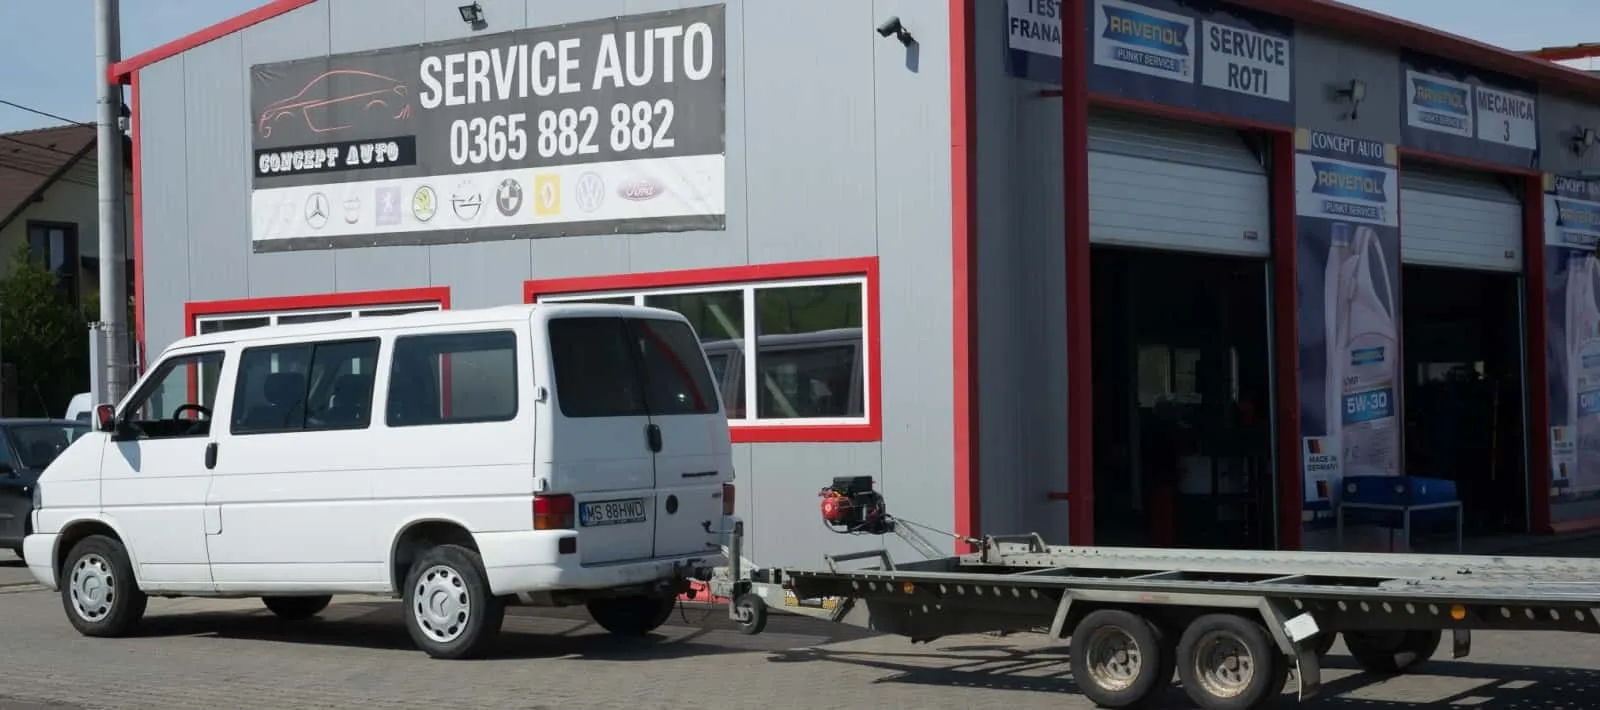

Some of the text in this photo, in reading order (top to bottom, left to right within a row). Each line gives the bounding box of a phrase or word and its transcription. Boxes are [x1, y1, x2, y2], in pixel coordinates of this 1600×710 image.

[1109, 16, 1183, 47] RAVENOL
[1210, 26, 1284, 66] SERVICE
[420, 22, 713, 109] SERVICE AUTO
[1118, 47, 1176, 71] PUNKT SERVICE
[1228, 62, 1268, 95] ROTI
[1478, 90, 1534, 121] MECANICA
[450, 99, 675, 166] 0365 882 882
[1312, 132, 1383, 159] CONCEPT AUTO
[1503, 120, 1510, 142] 3
[259, 142, 399, 173] CONCEPT AUTO
[1318, 170, 1382, 194] RAVENOL
[1346, 391, 1388, 414] 5W-30
[587, 505, 603, 521] MS
